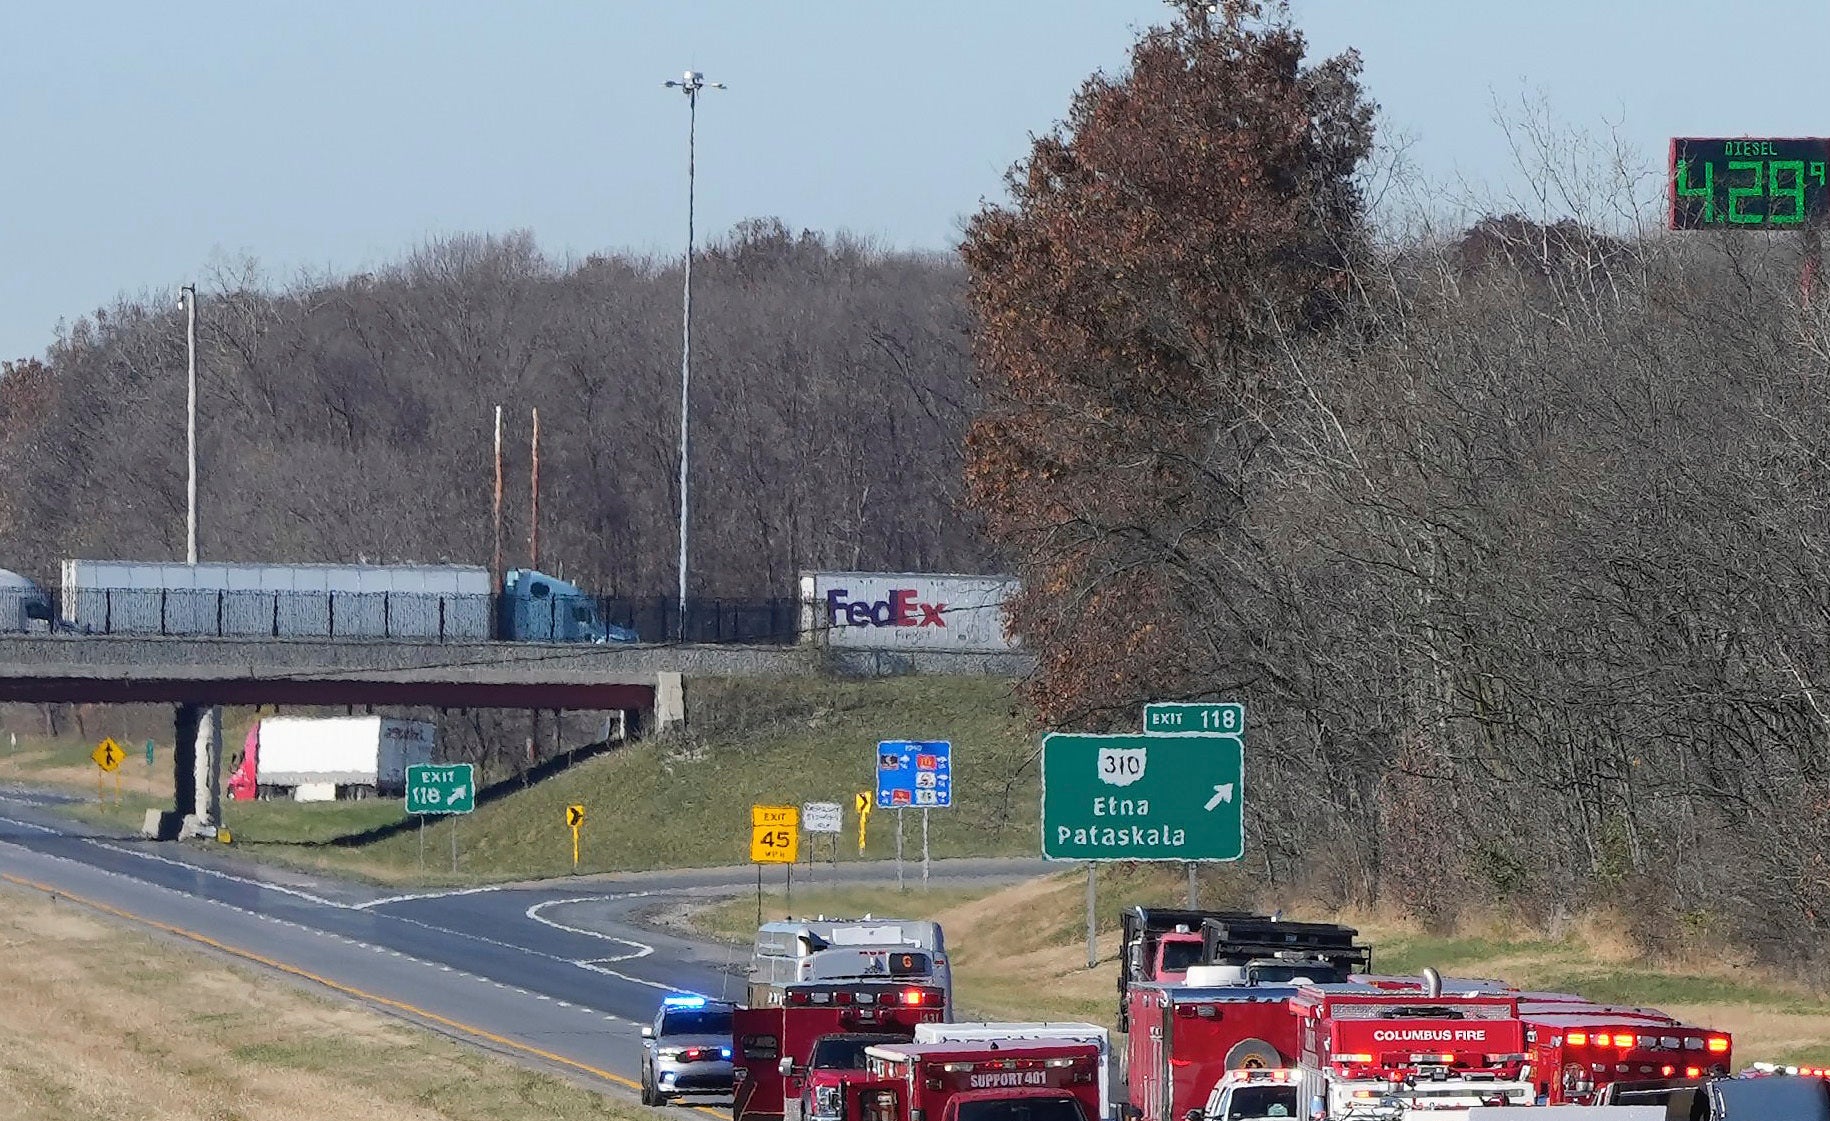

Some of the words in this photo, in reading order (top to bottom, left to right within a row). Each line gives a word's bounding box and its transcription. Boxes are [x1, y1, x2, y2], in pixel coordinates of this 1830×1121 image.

[1725, 141, 1778, 156] DIESEL
[827, 589, 948, 628] FedEx
[1152, 712, 1183, 726] EXIT
[1200, 709, 1236, 729] 118
[1104, 755, 1140, 775] 310
[421, 771, 454, 783] EXIT
[412, 786, 441, 805] 118
[1093, 797, 1149, 816] Etna
[764, 813, 786, 821] EXIT
[760, 831, 790, 848] 45
[1057, 824, 1185, 846] Pataskala
[1373, 1030, 1452, 1041] COLUMBUS
[1455, 1030, 1486, 1041] FIRE
[970, 1072, 1023, 1088] SUPPORT
[1024, 1071, 1046, 1085] 401
